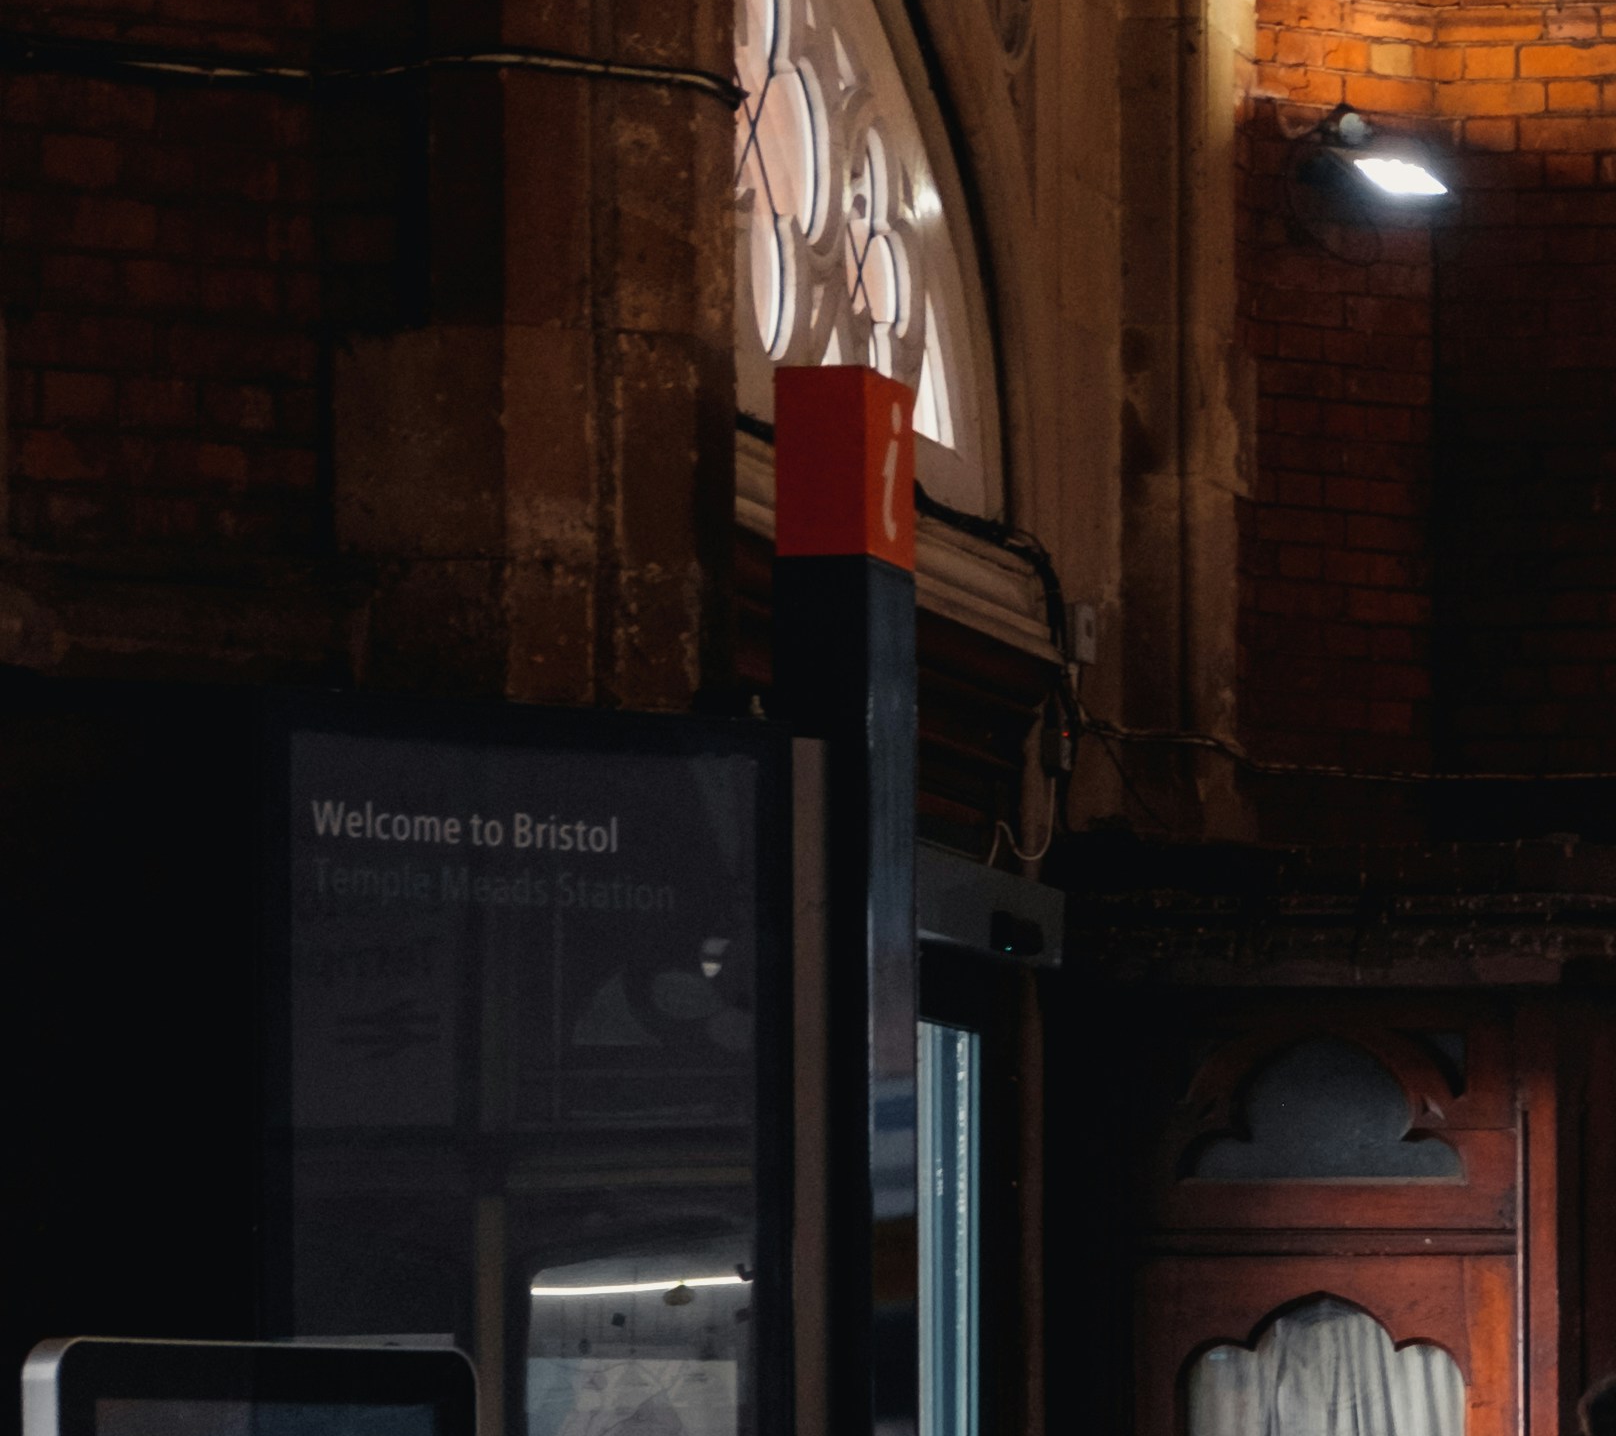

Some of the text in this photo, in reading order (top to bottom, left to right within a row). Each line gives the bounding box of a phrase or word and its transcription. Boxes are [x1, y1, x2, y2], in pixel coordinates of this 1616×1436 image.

[312, 800, 619, 853] Welcome to Bristol
[314, 857, 675, 912] Temple Meads Station
